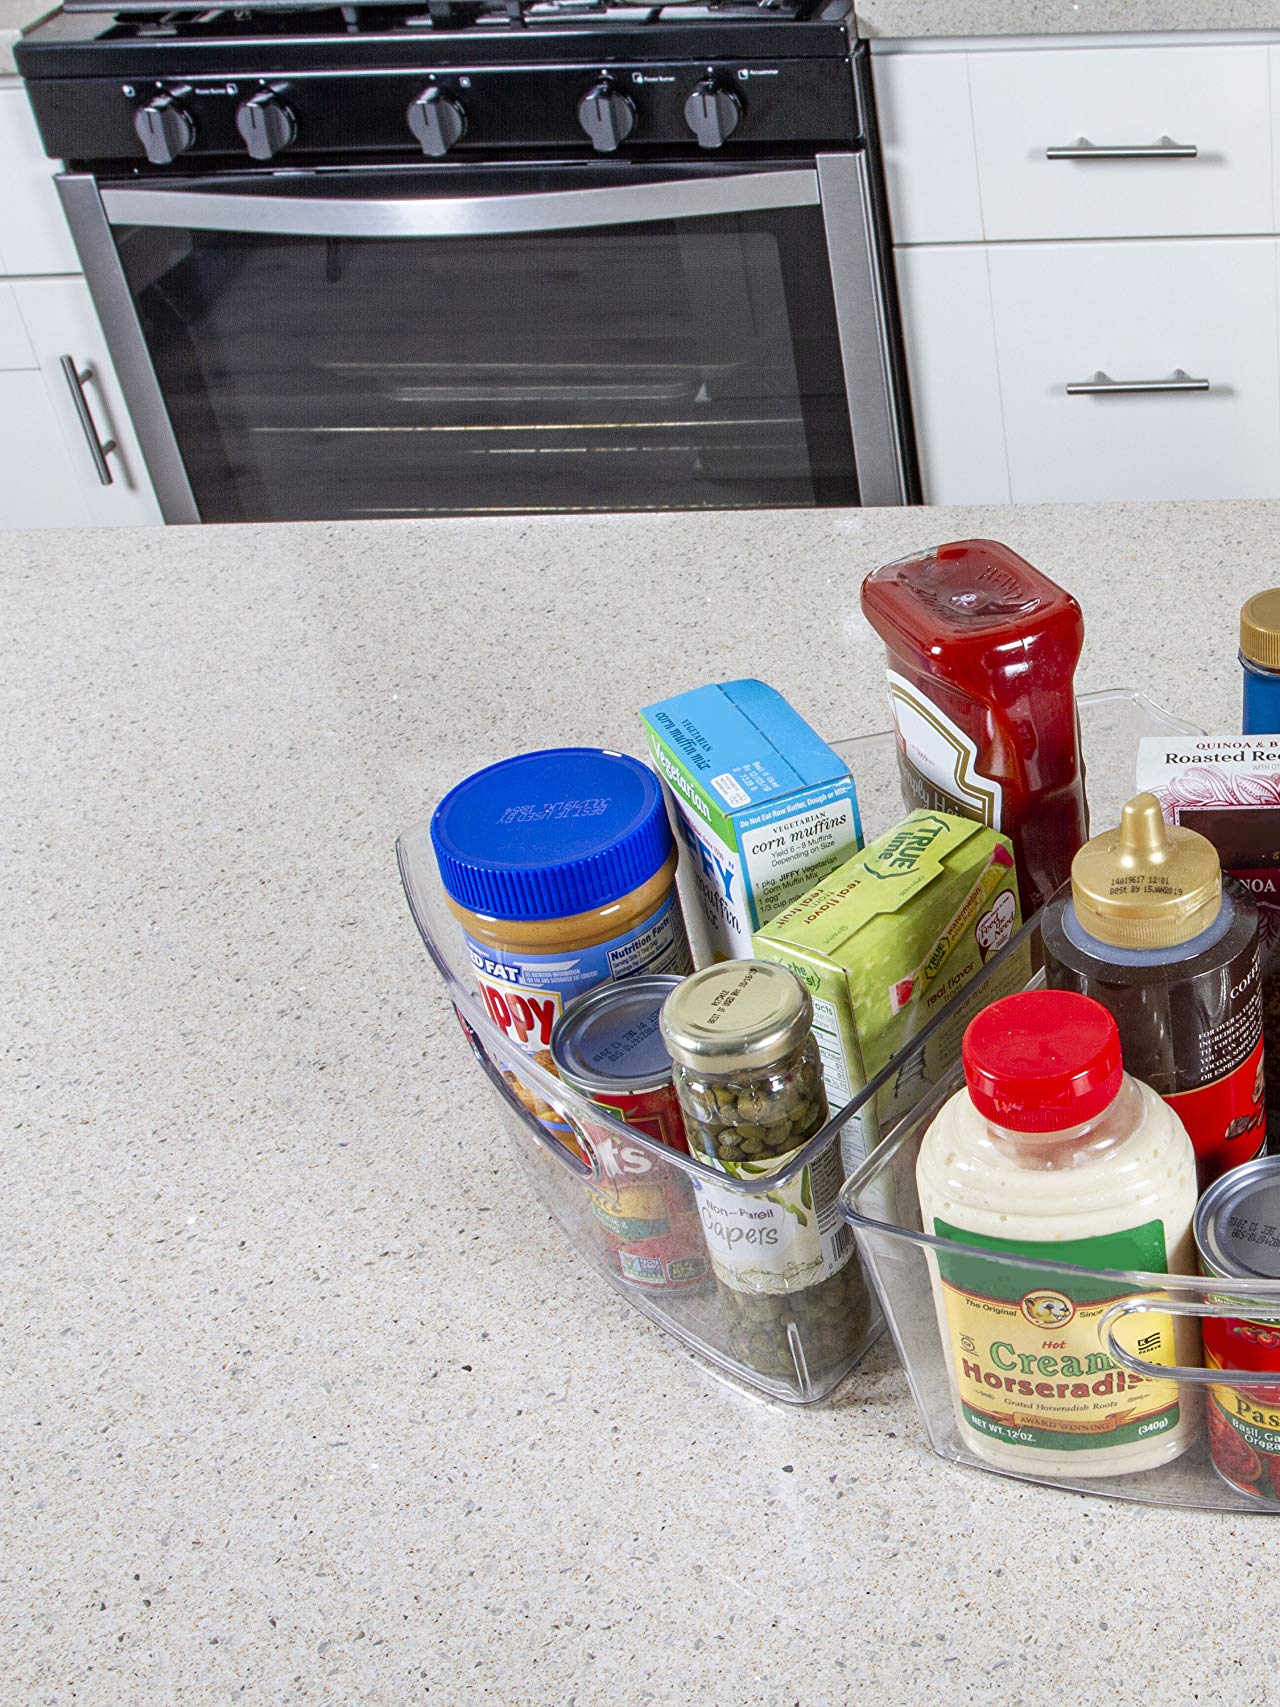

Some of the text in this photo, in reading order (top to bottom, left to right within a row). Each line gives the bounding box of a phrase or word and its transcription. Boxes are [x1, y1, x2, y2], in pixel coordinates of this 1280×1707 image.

[655, 711, 676, 730] corn
[669, 728, 698, 756] muffin
[681, 718, 713, 753] VEGETARIAN
[1196, 741, 1251, 751] QUINOA
[1257, 741, 1264, 749] &
[1165, 750, 1246, 765] Roasted
[651, 733, 713, 823] Vegetarian
[740, 819, 749, 828] Do
[749, 814, 761, 825] Not
[761, 810, 772, 821] Eat
[772, 807, 786, 818] Raw
[807, 794, 827, 807] Dough
[772, 811, 826, 834] VEGETARIAN
[751, 814, 848, 856] corn muffins
[771, 848, 789, 859] Yield
[807, 833, 833, 847] Muffins
[877, 831, 915, 860] lime
[888, 826, 944, 870] TRUE
[771, 840, 835, 868] Depending on Size
[779, 869, 800, 882] JIFFY
[800, 856, 838, 874] Vegetarian
[762, 872, 819, 896] Corn Muffin Mix
[772, 898, 788, 909] cup
[799, 888, 825, 907] real
[804, 879, 861, 926] real flavor
[809, 891, 835, 909] from
[946, 886, 982, 937] watermelon
[611, 934, 651, 962] Nutrition
[652, 915, 670, 938] Facts
[980, 911, 1000, 941] Feed
[993, 916, 1015, 943] Need
[927, 940, 945, 971] TRUE
[484, 959, 519, 982] FAT
[927, 988, 946, 1008] real
[947, 960, 976, 992] flavor
[1200, 1073, 1213, 1082] OR
[701, 1206, 780, 1251] Capers
[965, 1298, 1018, 1318] The Original
[1079, 1308, 1104, 1319] Since
[1041, 1340, 1068, 1349] Hot
[1003, 1397, 1118, 1412] Grated Horseradish Roots
[971, 1415, 988, 1428] NET
[989, 1422, 1005, 1435] WT.
[1019, 1416, 1111, 1431] AWARD WINNING
[1138, 1417, 1169, 1437] (340g)
[1231, 1417, 1260, 1441] Basil,
